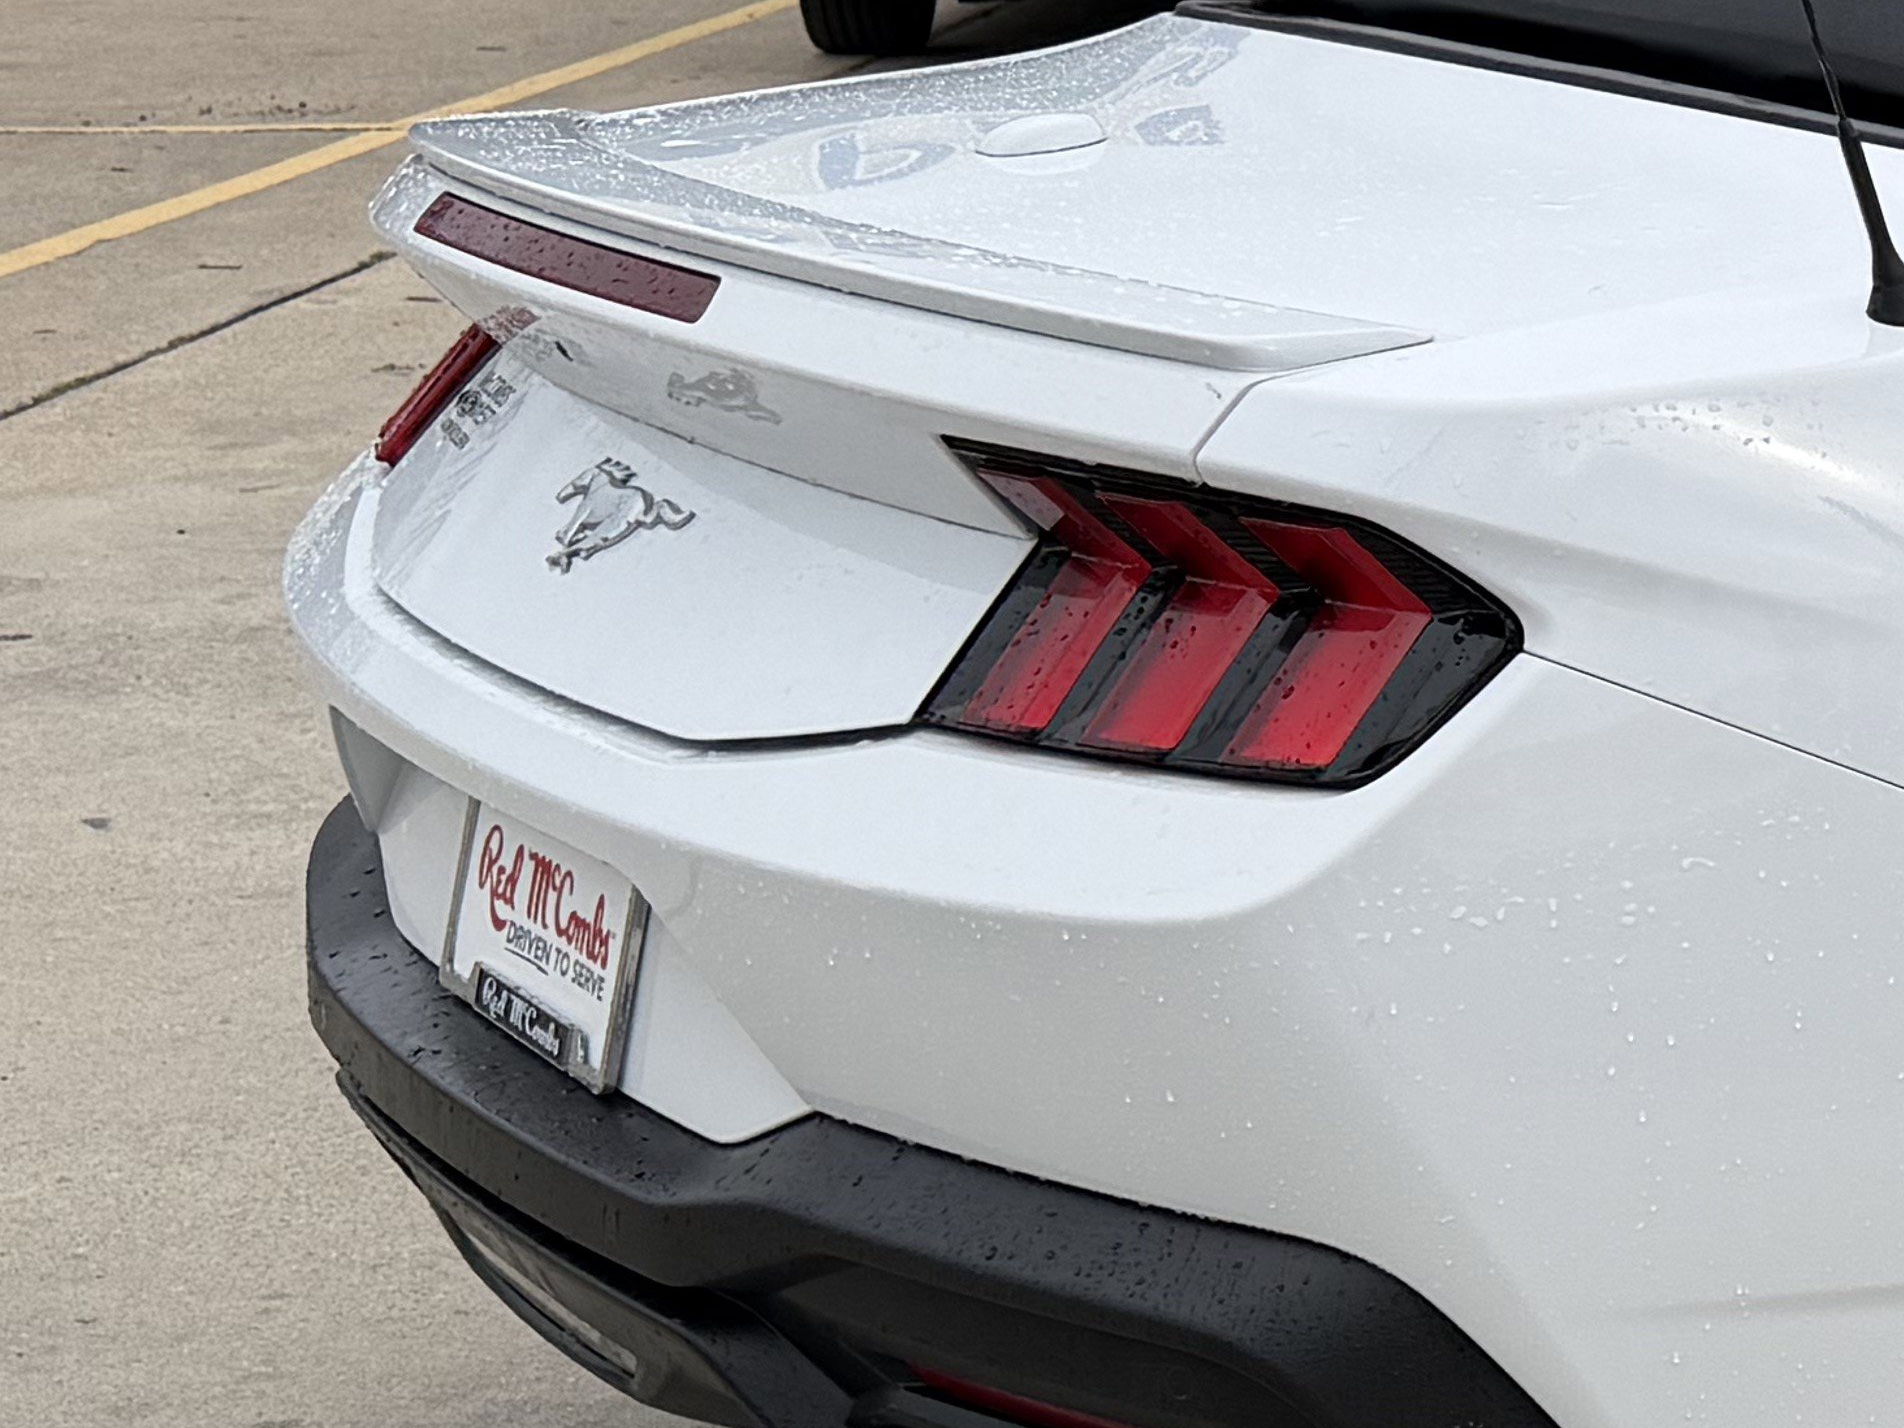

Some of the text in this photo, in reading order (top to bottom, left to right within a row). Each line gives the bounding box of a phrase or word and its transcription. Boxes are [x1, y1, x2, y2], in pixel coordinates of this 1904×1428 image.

[478, 824, 612, 970] Red McCombs
[482, 976, 508, 1018] Red
[505, 920, 606, 1002] DRIVEN TO SERVE
